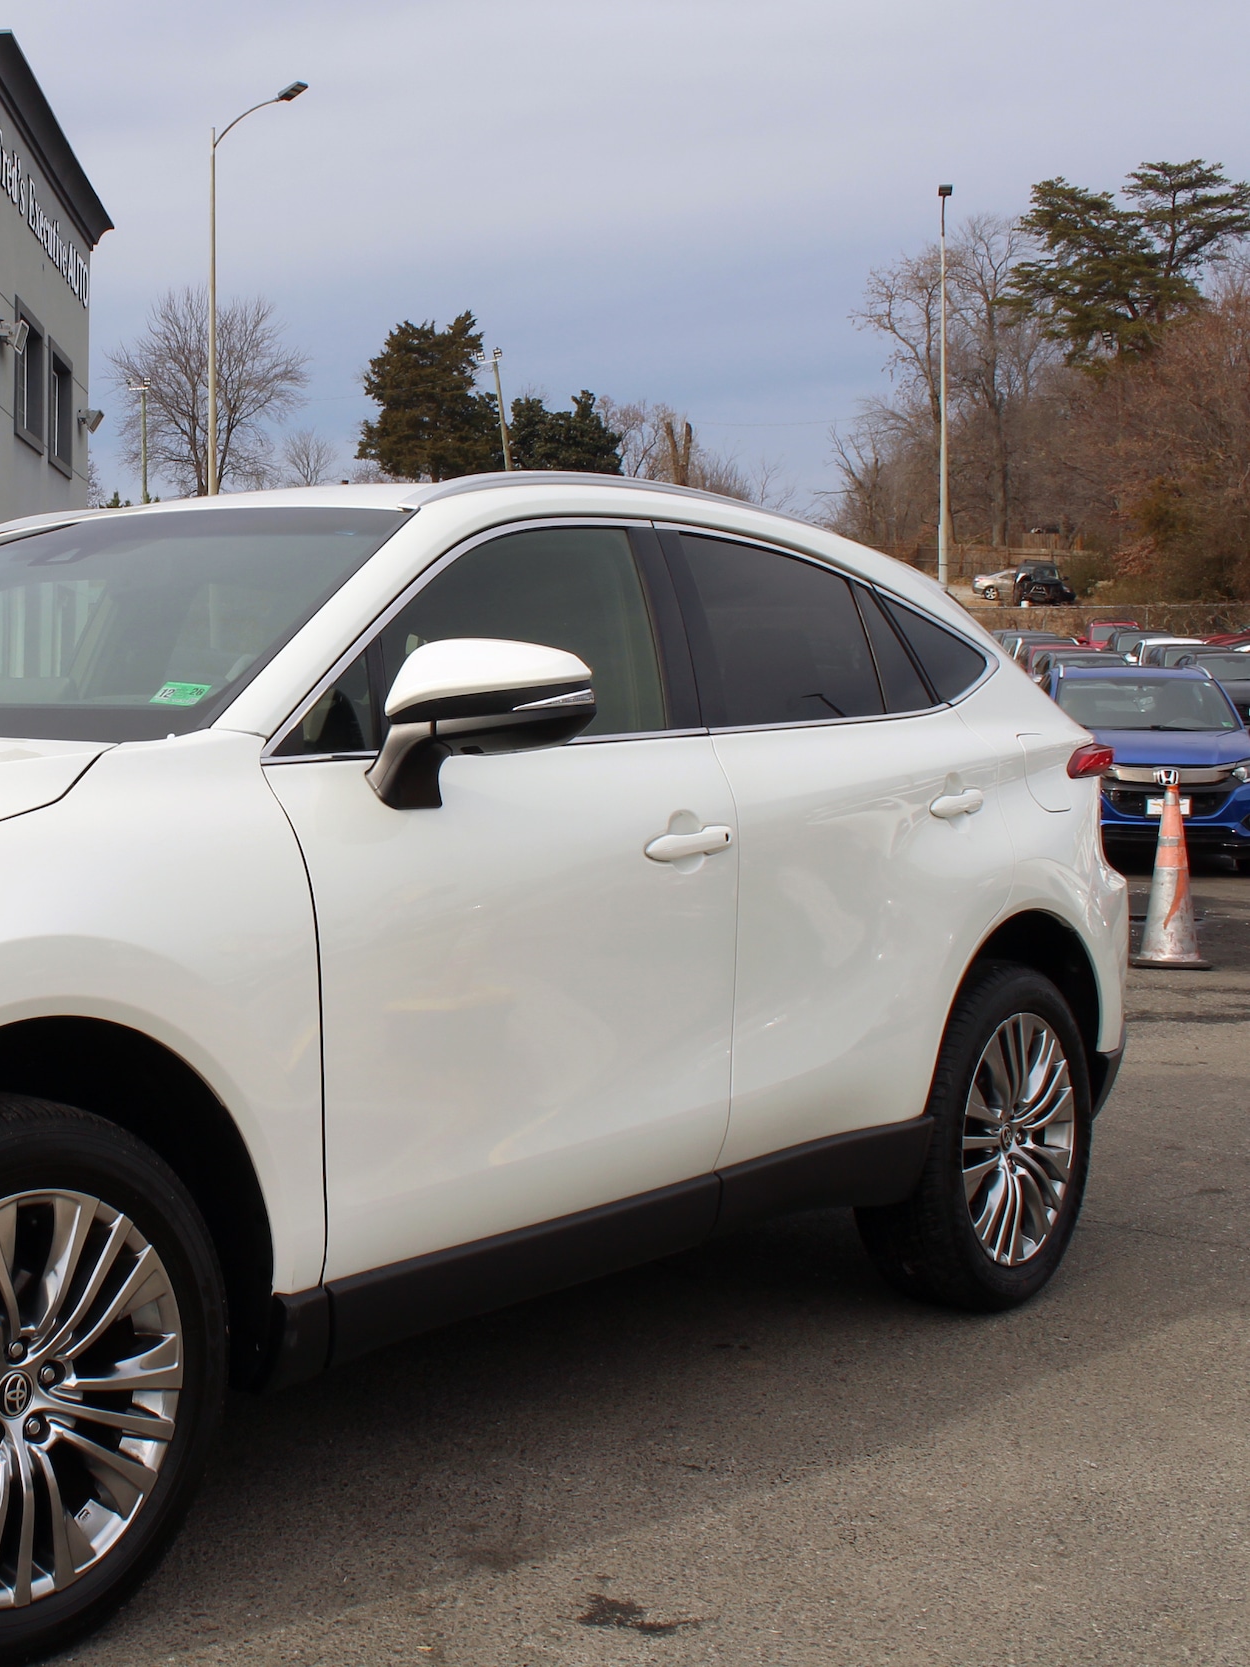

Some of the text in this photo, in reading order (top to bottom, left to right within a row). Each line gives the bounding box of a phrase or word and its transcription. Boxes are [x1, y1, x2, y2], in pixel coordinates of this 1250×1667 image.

[27, 174, 67, 278] Executive
[66, 241, 90, 309] AUTO
[158, 688, 176, 698] 12
